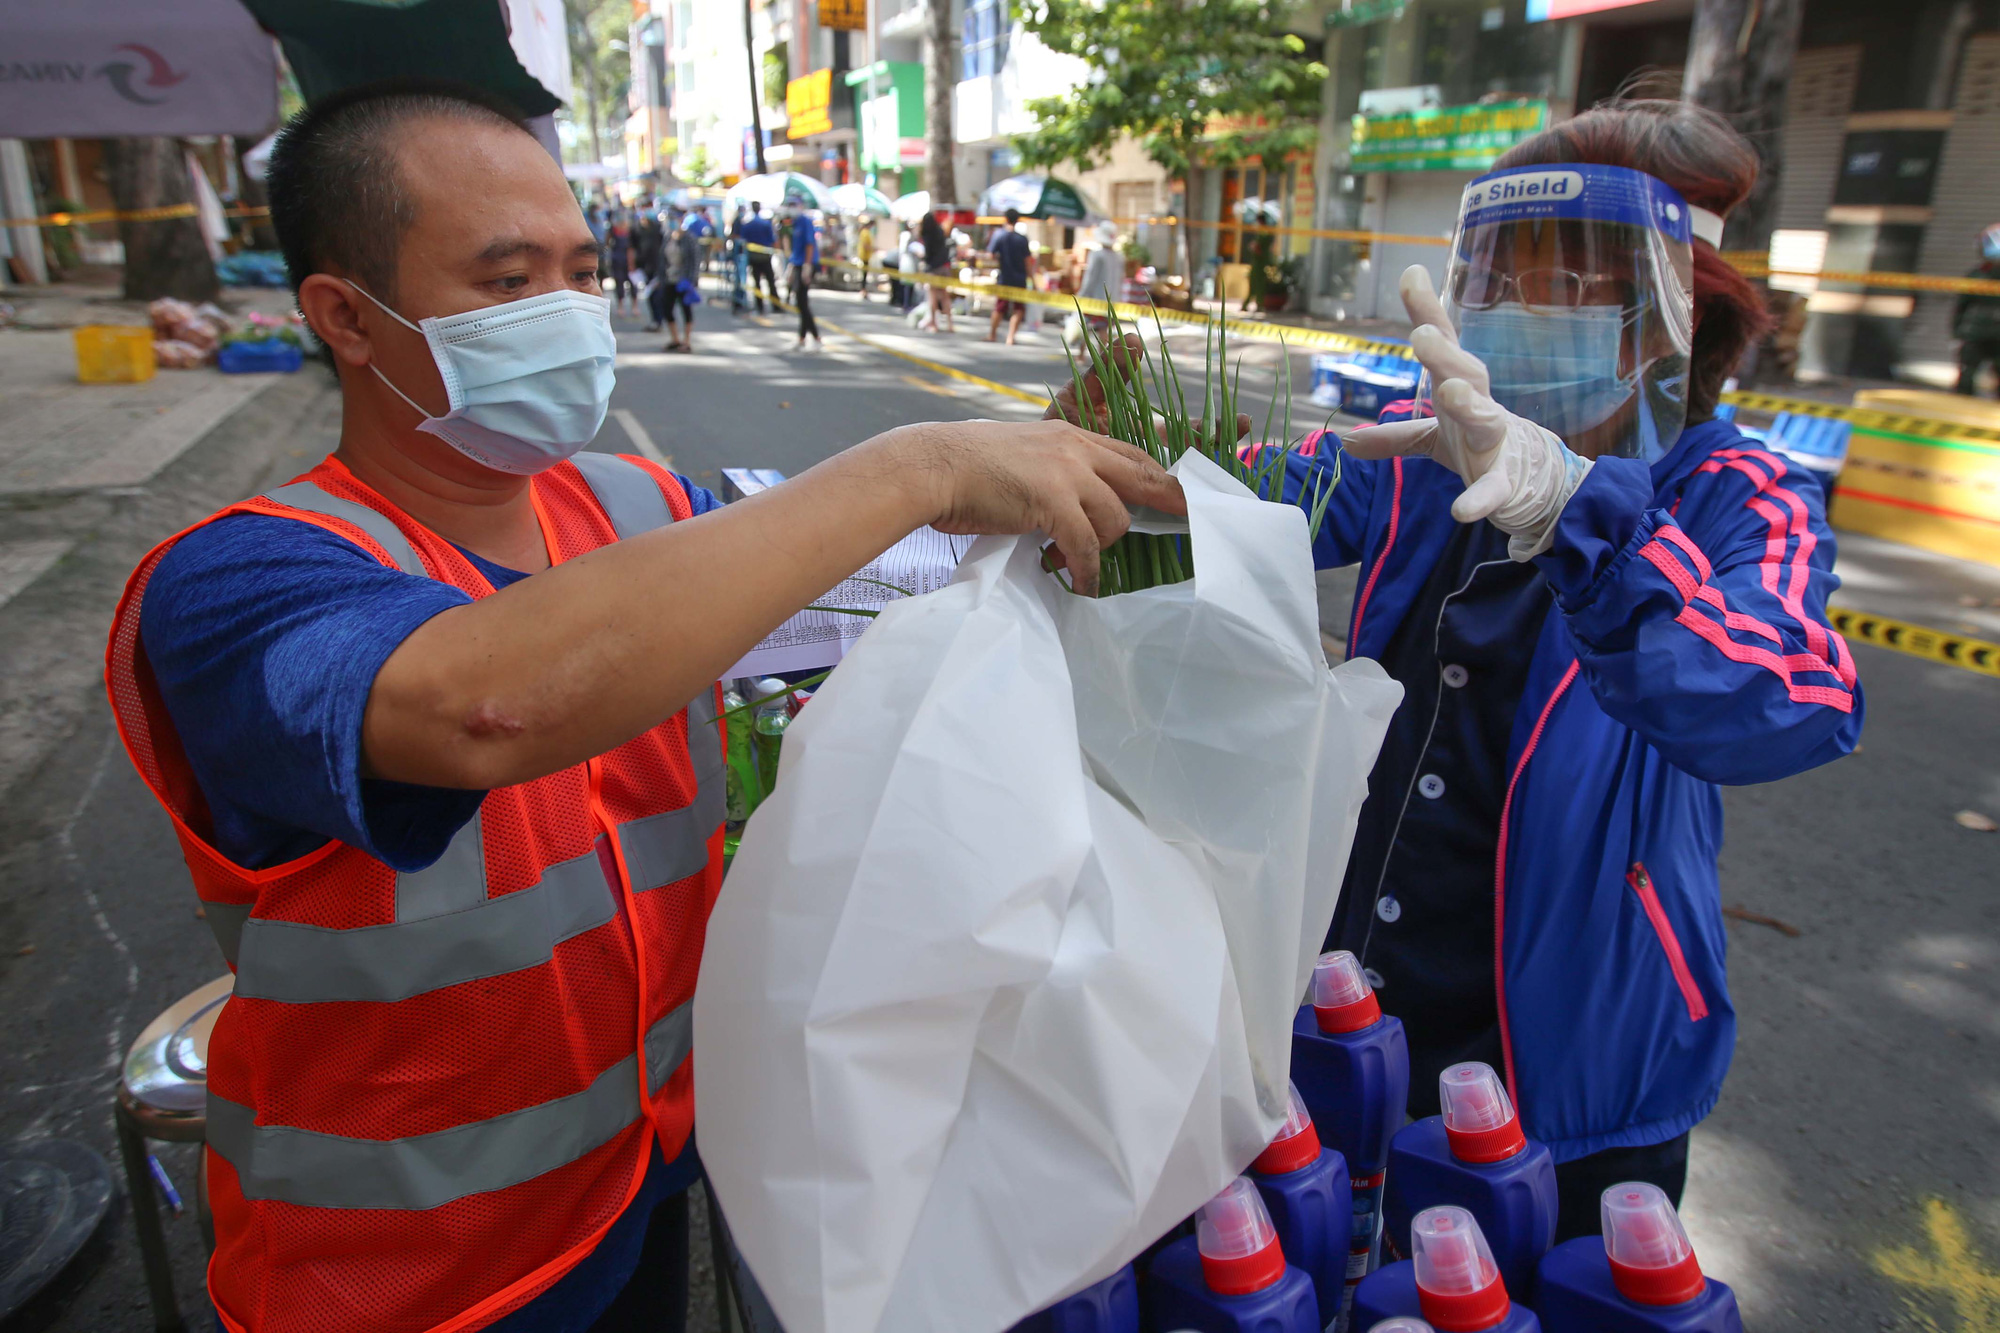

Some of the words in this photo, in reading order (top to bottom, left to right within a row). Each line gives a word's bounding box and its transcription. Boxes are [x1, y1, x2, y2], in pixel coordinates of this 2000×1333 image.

[1488, 177, 1568, 200] Shield
[1526, 205, 1554, 213] Mask
[458, 442, 491, 463] Mask
